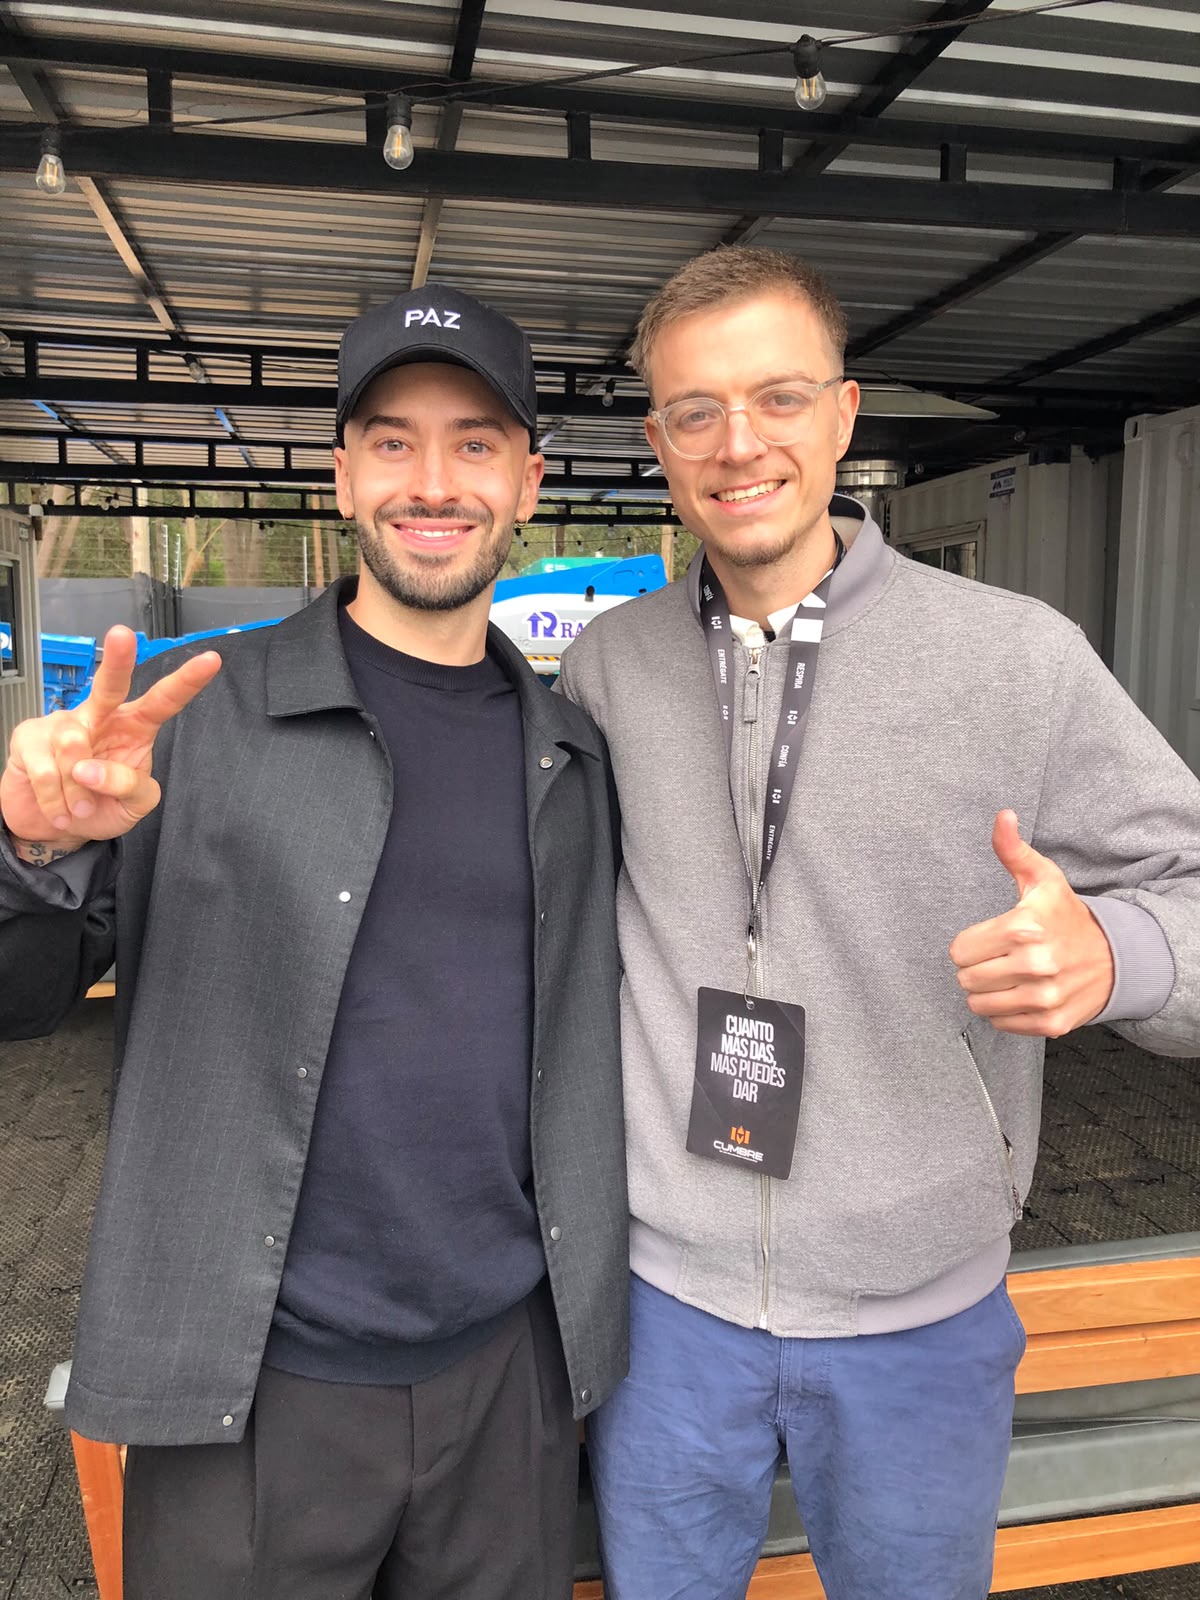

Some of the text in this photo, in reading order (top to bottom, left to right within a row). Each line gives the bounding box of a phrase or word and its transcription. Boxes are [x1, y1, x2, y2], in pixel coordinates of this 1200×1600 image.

[405, 307, 462, 330] PAZ
[793, 662, 806, 690] RESPIRA
[777, 744, 790, 768] CONFÍA
[725, 1014, 774, 1043] CUANTO
[738, 1058, 786, 1088] PUEDES
[732, 1078, 759, 1103] DAR
[713, 1140, 764, 1162] CUMBRE
